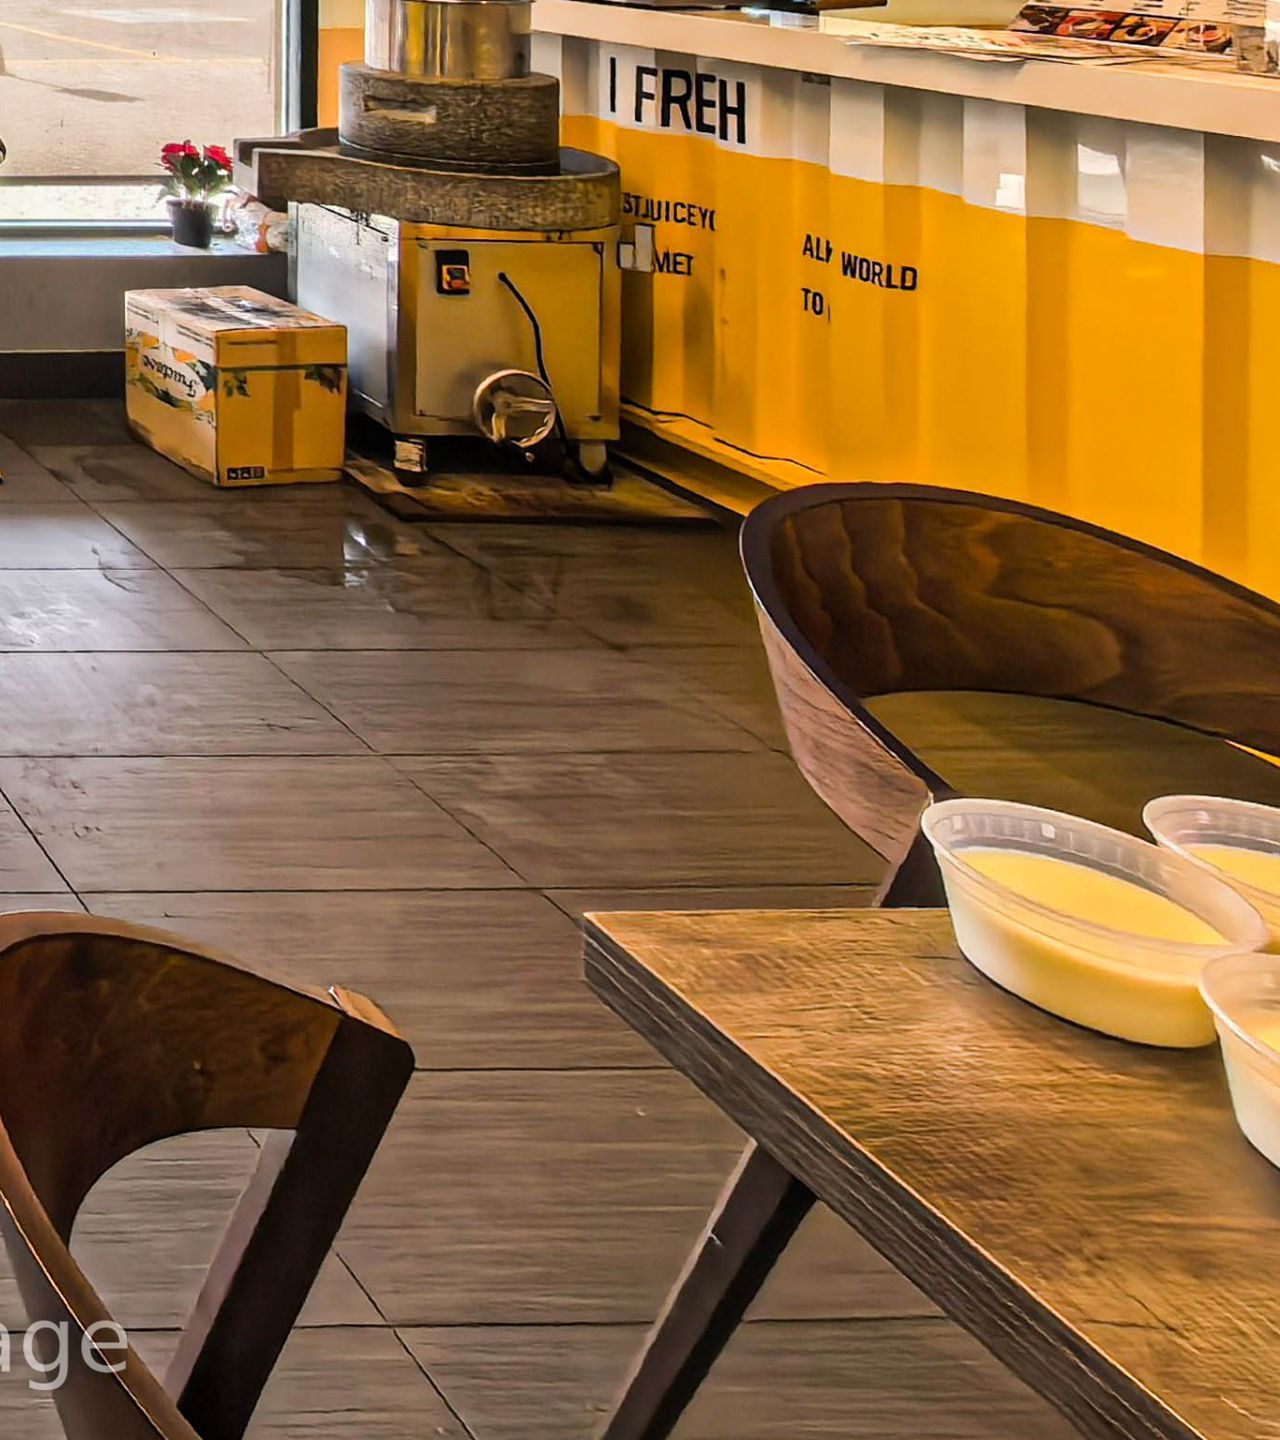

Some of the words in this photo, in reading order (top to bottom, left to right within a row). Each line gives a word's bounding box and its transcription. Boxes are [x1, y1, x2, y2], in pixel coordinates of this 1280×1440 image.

[608, 56, 617, 113] I
[841, 251, 918, 292] WORLD
[801, 287, 824, 316] TO
